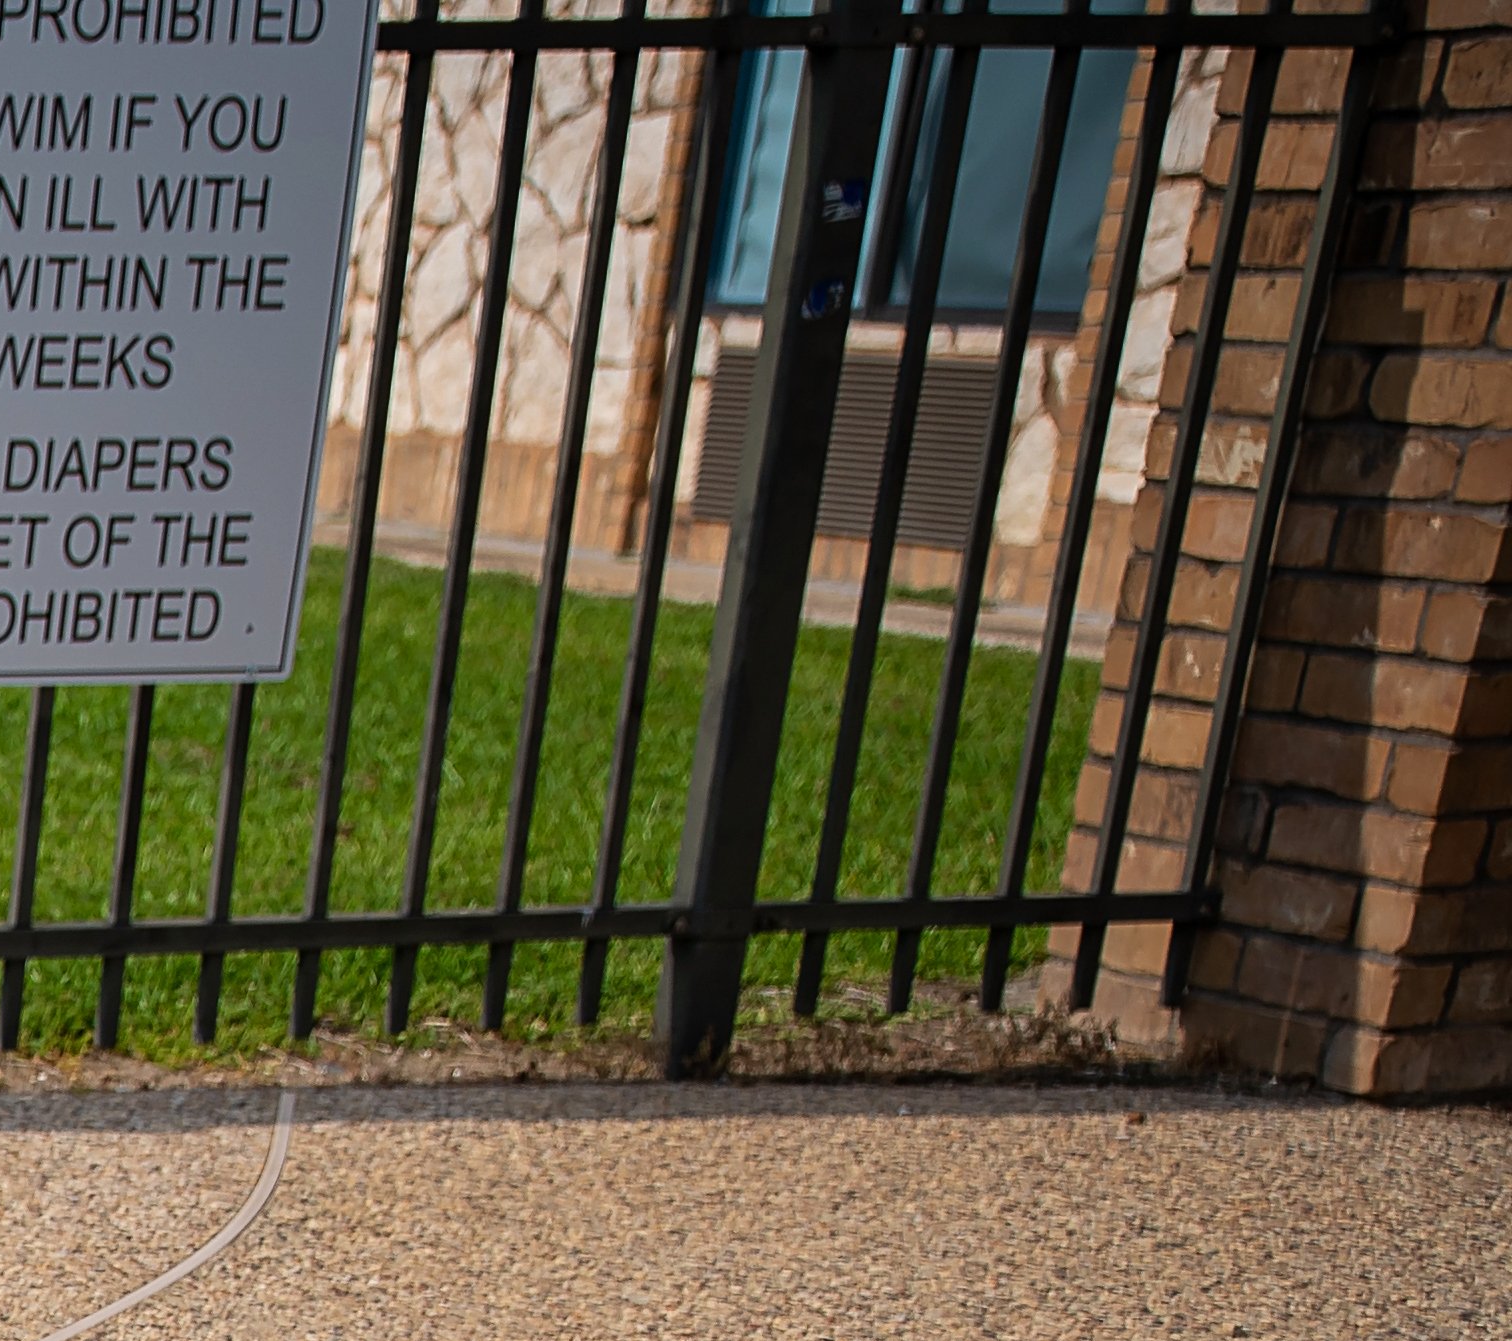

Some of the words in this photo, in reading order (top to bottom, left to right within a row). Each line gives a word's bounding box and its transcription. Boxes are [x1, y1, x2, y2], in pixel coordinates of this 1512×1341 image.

[109, 93, 158, 151] IF
[174, 93, 287, 152] YOU
[44, 174, 117, 232] ILL
[136, 174, 271, 232] WITH
[185, 254, 290, 311] THE
[2, 436, 232, 493] DIAPERS
[62, 513, 136, 569] OF
[151, 512, 253, 568] THE
